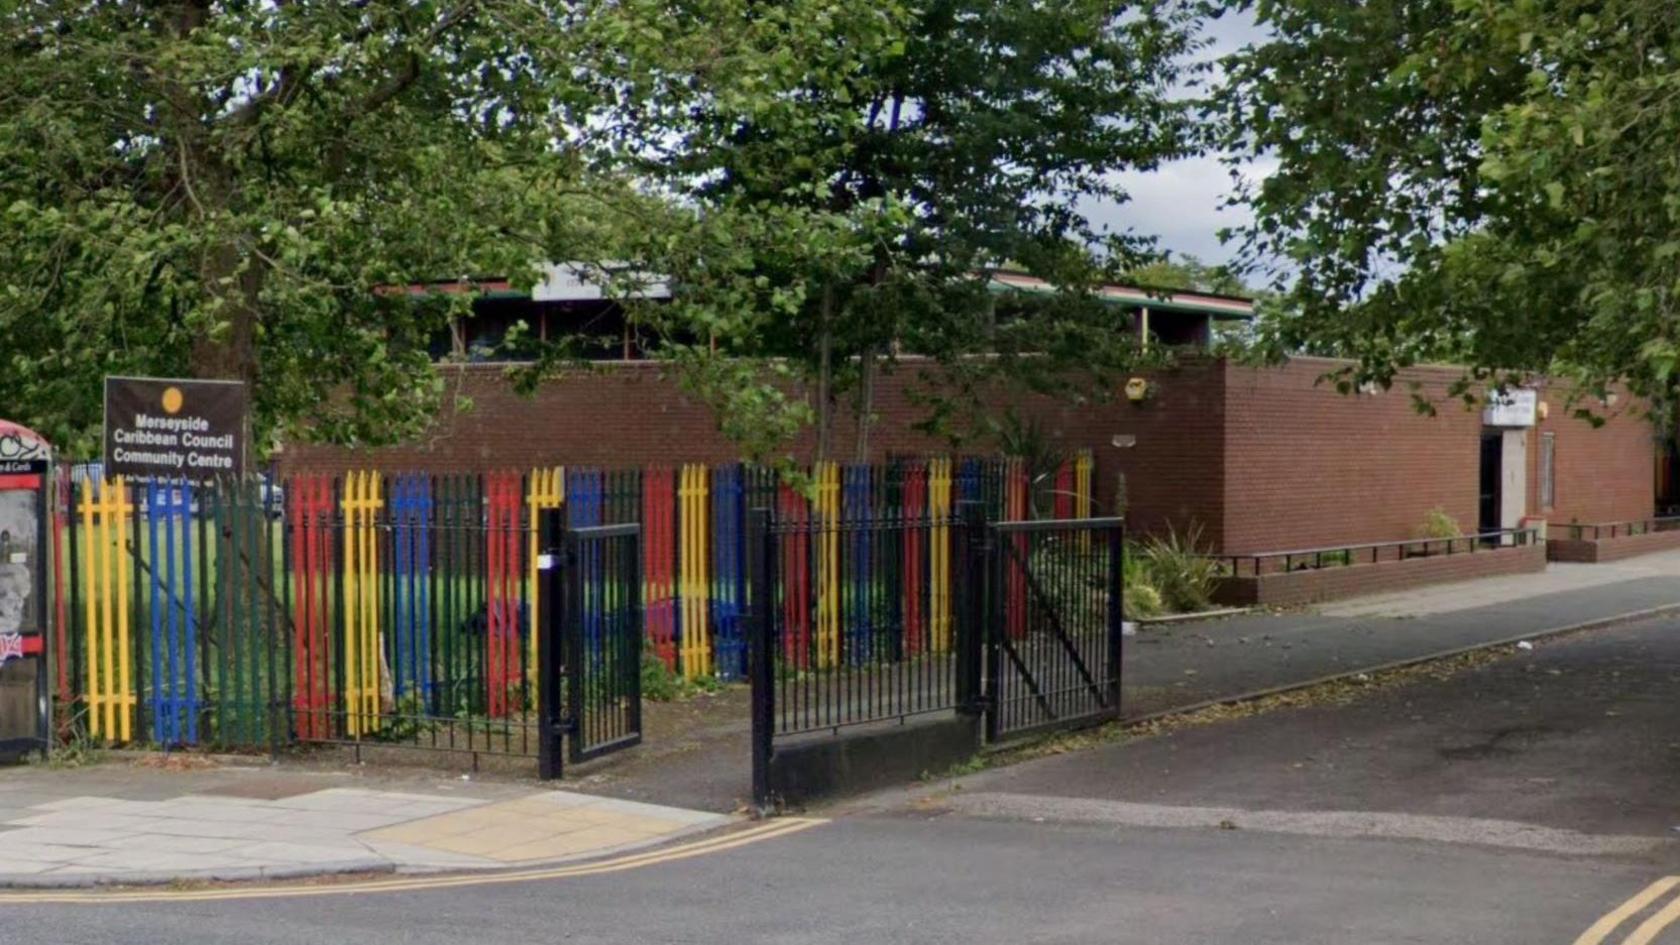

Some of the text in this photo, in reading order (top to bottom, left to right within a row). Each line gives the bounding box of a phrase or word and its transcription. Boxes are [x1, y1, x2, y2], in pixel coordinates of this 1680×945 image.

[135, 414, 209, 432] Merseyside
[114, 428, 233, 449] Caribbean Council
[114, 447, 232, 468] Community Centre
